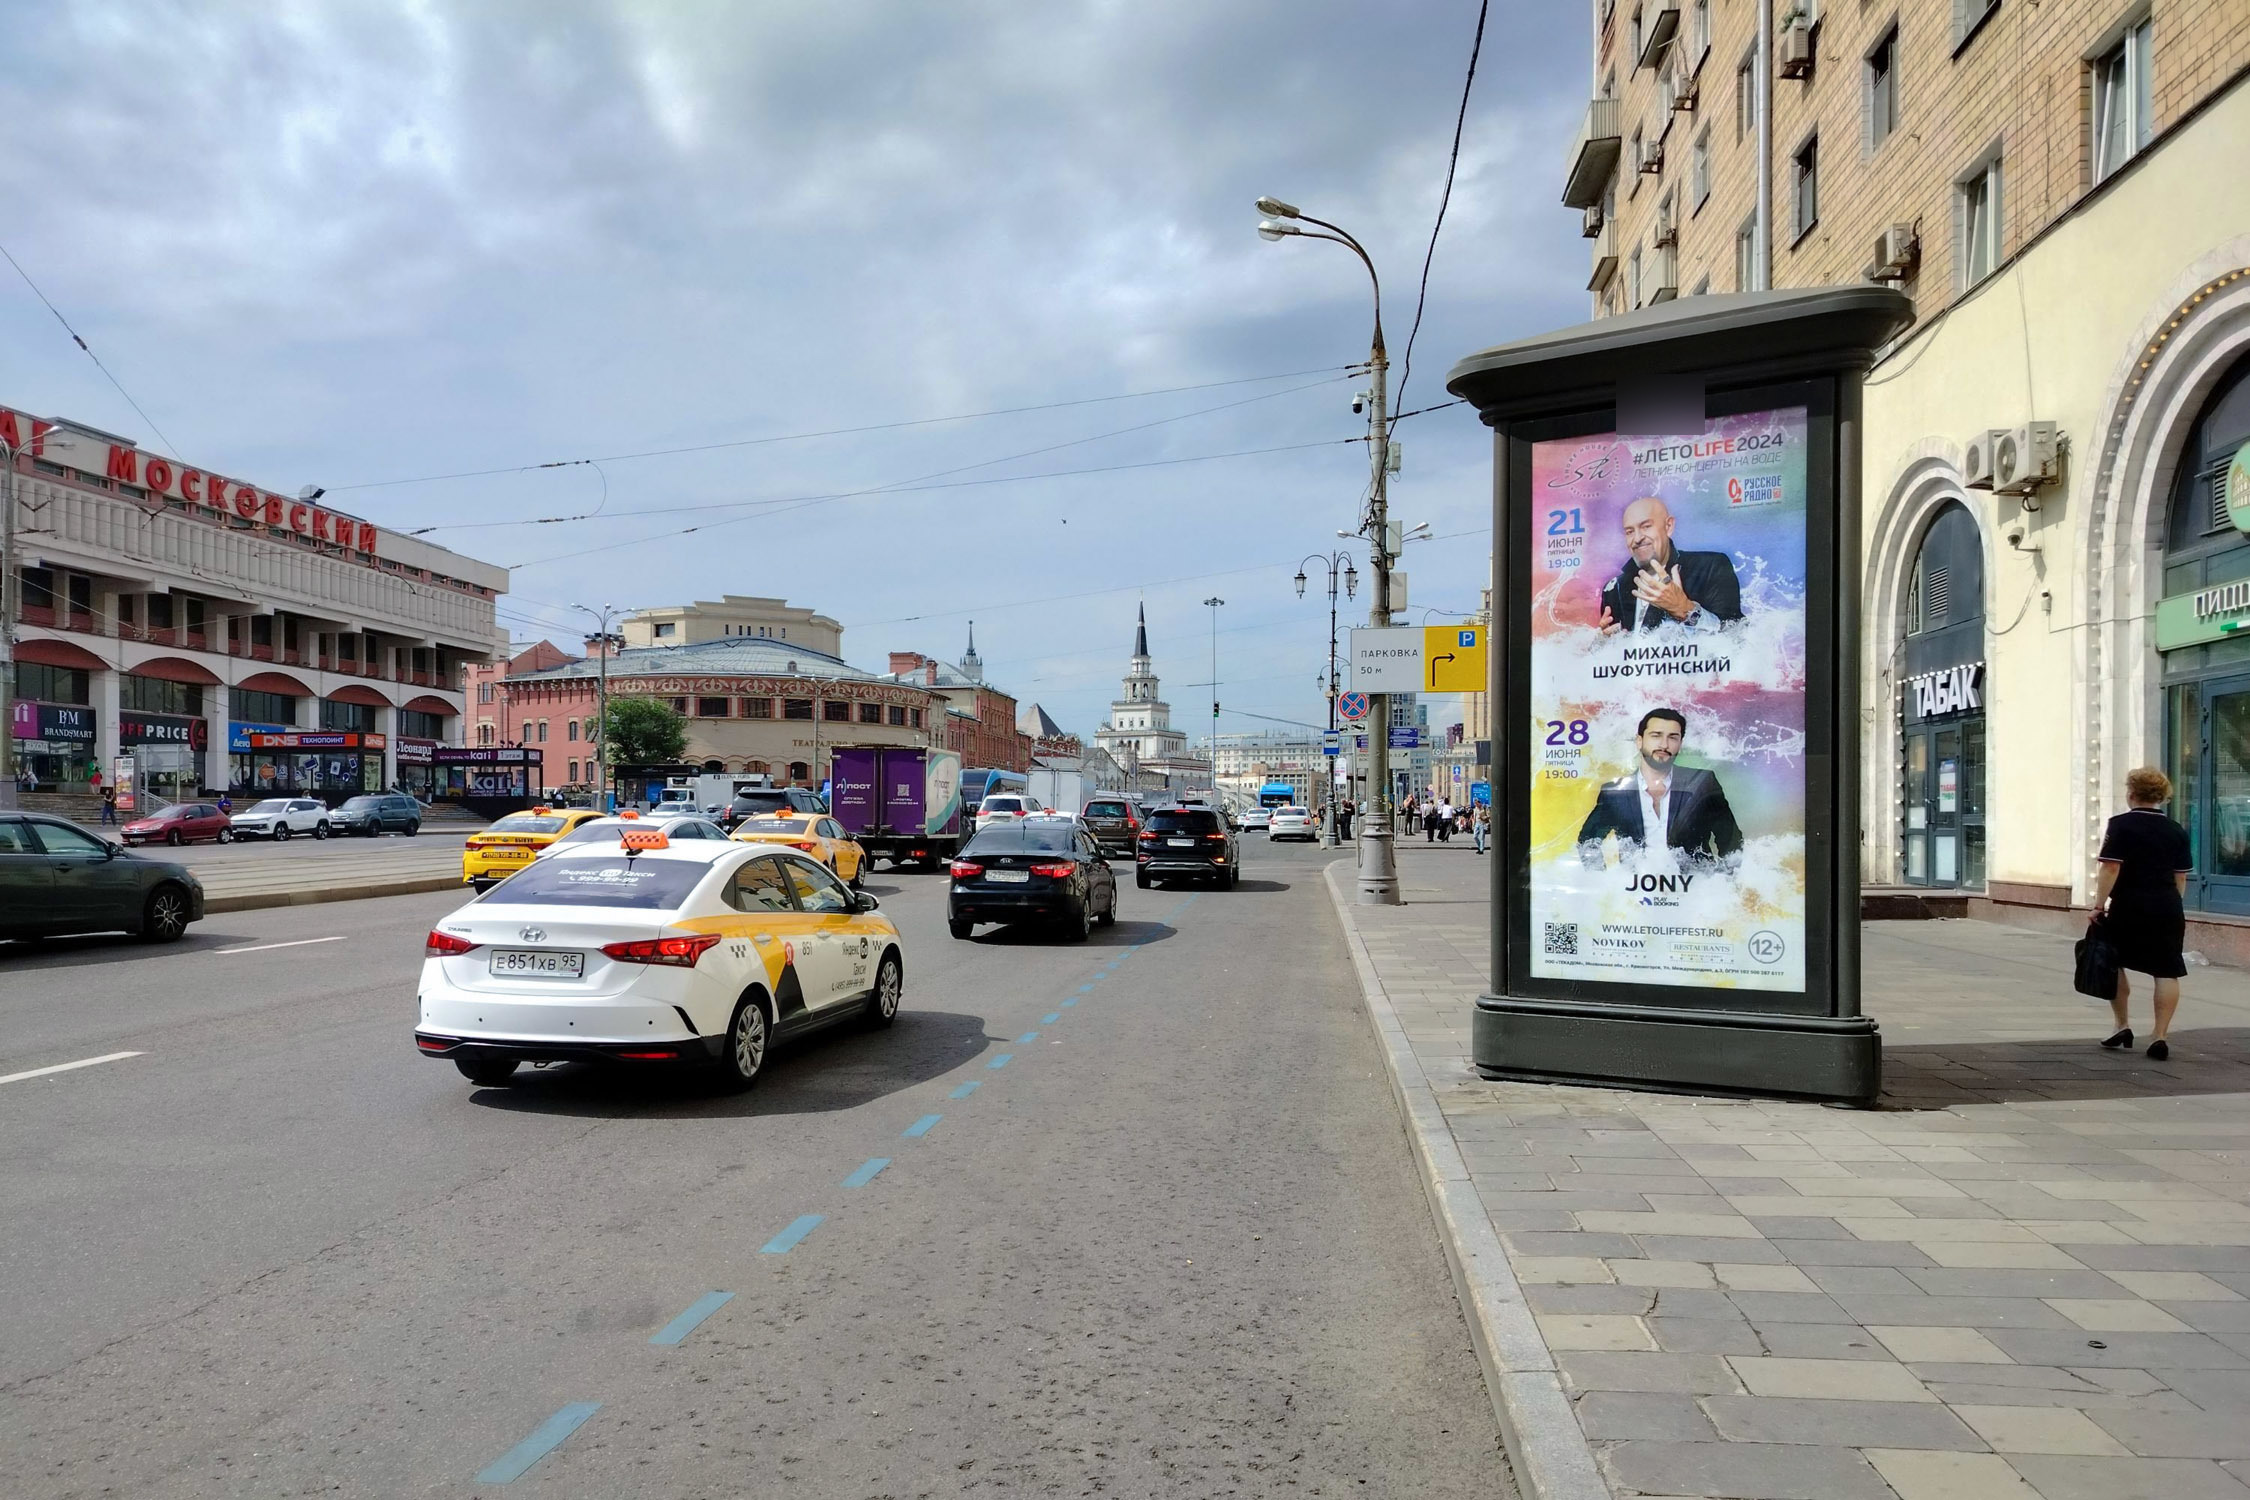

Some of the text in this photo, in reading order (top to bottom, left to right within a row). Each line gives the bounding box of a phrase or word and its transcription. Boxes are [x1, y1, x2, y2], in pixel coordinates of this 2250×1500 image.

[1633, 433, 1784, 465] #ЛЕТОLIFE2024
[1632, 463, 1673, 479] ЛЕТНИЕ
[1675, 458, 1732, 475] КОНЦЕРТЫ
[1734, 456, 1749, 467] НА
[1751, 452, 1782, 464] ВОДЕ
[107, 444, 376, 553] МОСКОВСКИЙ
[1548, 508, 1585, 536] 21
[1548, 537, 1583, 549] ИЮНЯ
[1548, 557, 1580, 568] 19:00
[1361, 649, 1419, 658] ПАРКОВКА
[1624, 644, 1698, 661] МИХАИЛ
[1361, 666, 1373, 674] 50
[1593, 656, 1731, 678] ШУФУТИНСКИЙ
[1913, 667, 1982, 717] ТАБАК
[1546, 719, 1589, 746] 28
[263, 735, 298, 746] DNS
[302, 736, 344, 744] ТЕХНОПОИНТ
[365, 736, 384, 746] DNS
[397, 741, 432, 756] Леонард
[470, 751, 491, 760] kari
[1545, 749, 1581, 758] ИЮНЯ
[1545, 769, 1578, 779] 19:00
[471, 774, 512, 789] kari
[1625, 874, 1694, 892] JONY
[1602, 924, 1724, 938] WWW.LETOLIFEFEST.RU
[802, 941, 812, 956] 851
[842, 942, 860, 956] Яндекс
[1592, 938, 1647, 949] NOVIKOV
[1674, 943, 1730, 953] RESTAURANTS
[1751, 939, 1782, 955] 12+
[562, 955, 577, 967] 95
[853, 962, 866, 976] Такси
